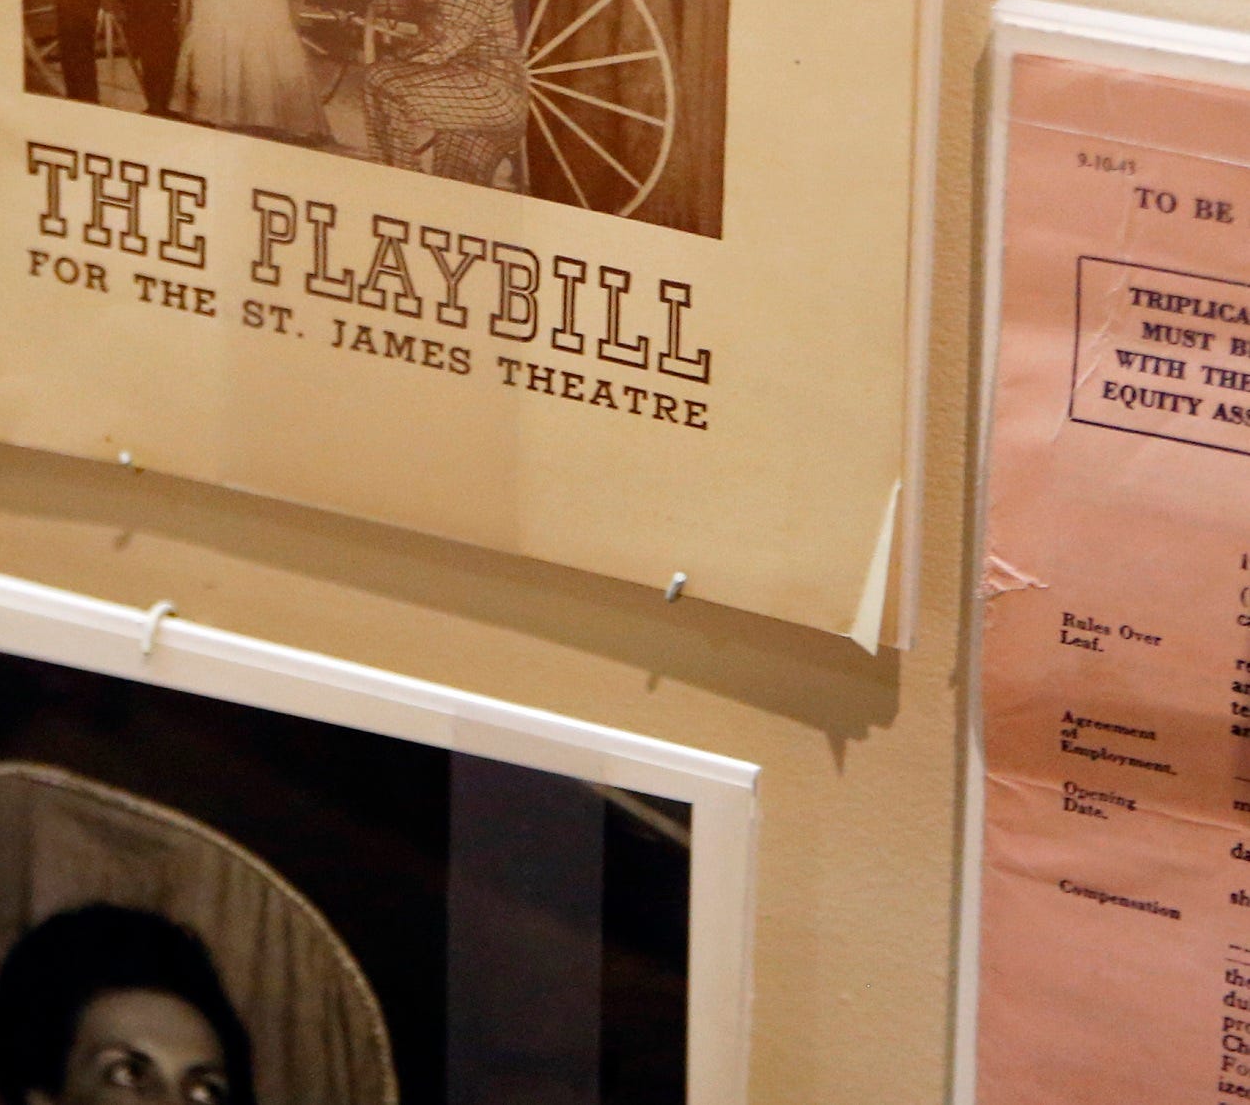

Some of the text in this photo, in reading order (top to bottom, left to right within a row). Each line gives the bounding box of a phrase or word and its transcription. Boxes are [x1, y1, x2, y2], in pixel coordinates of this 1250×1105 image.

[1134, 186, 1235, 224] TO BE
[27, 141, 711, 385] THE PLAYBILL
[28, 249, 709, 430] FOR THE ST. JAMES THEATRE
[1142, 321, 1216, 351] MUST
[1115, 349, 1186, 380] WITH
[1102, 380, 1203, 416] EQUITY
[1060, 630, 1105, 652] Leaf.
[1062, 611, 1163, 646] Rules Over
[1061, 711, 1157, 741] Agreement
[1061, 740, 1178, 776] Employment.
[1063, 780, 1137, 812] Opening
[1063, 797, 1109, 820] Date.
[1059, 878, 1182, 921] Compensation
